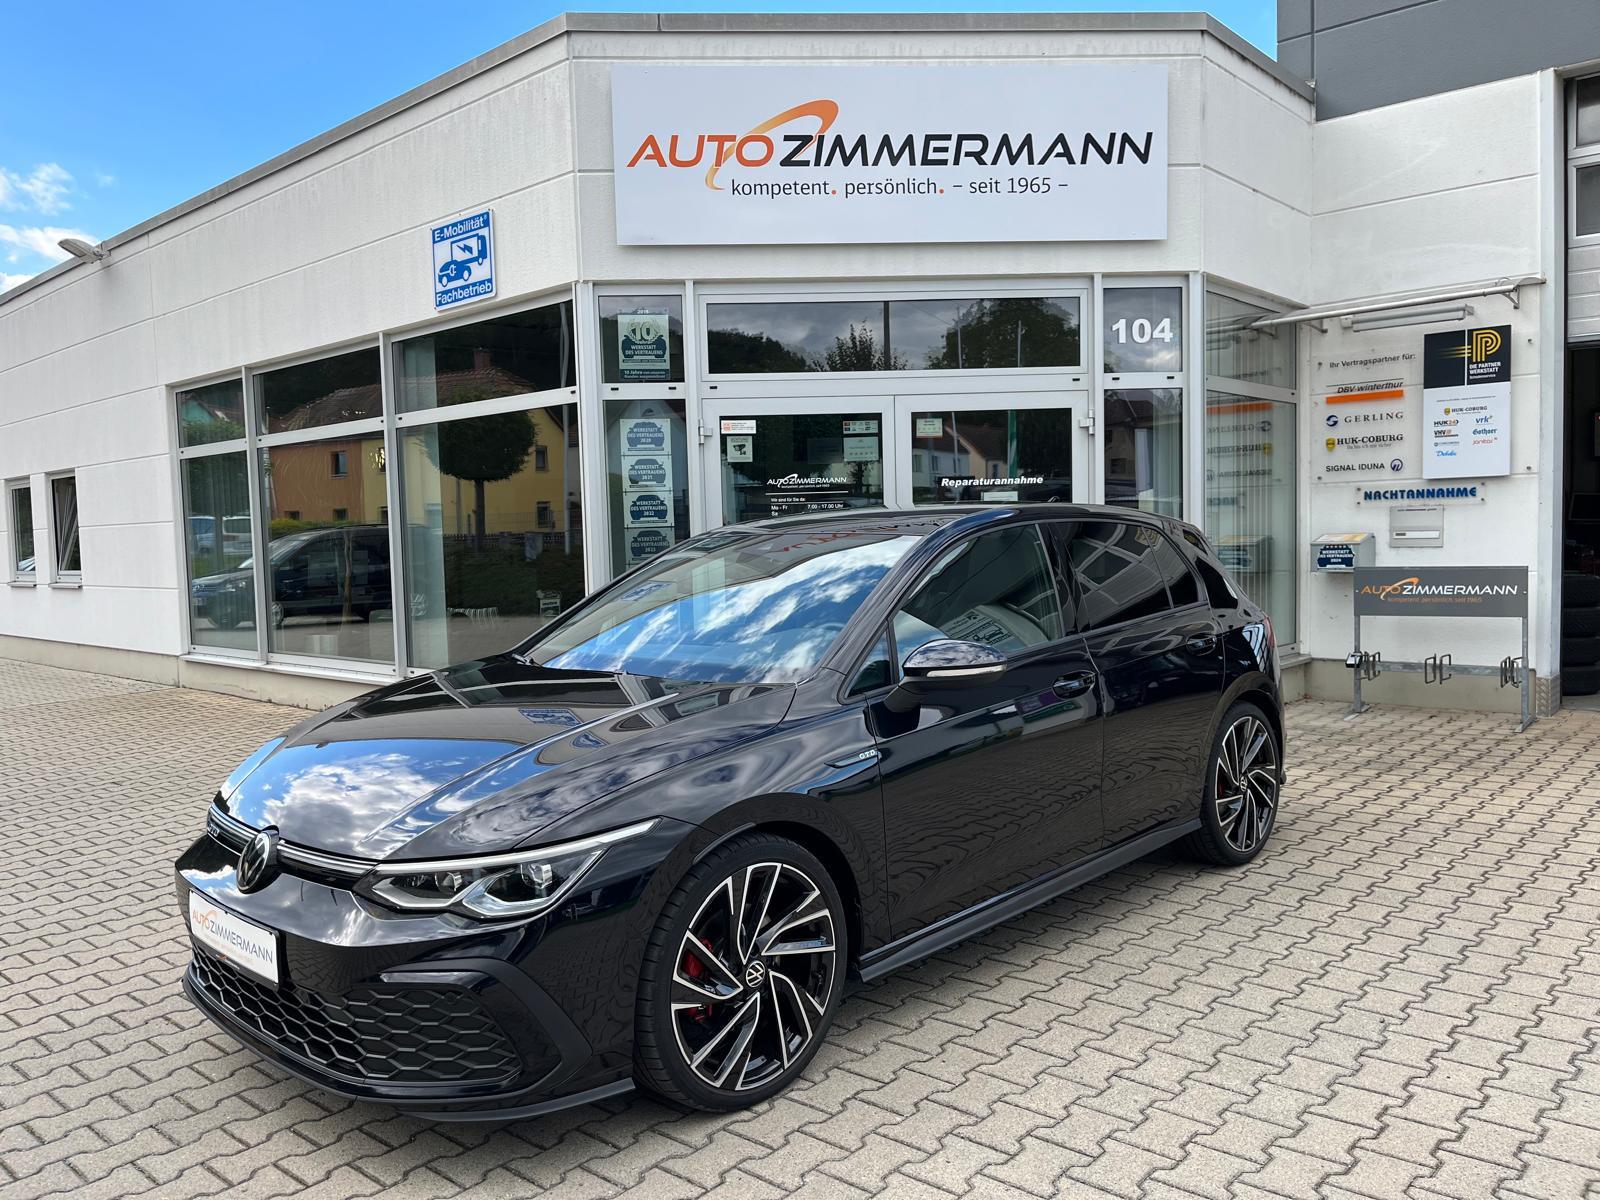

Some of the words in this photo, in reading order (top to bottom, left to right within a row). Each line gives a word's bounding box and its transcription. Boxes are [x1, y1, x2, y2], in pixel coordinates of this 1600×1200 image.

[731, 179, 838, 199] kompetent.
[845, 178, 945, 199] persönlich.
[969, 178, 1001, 194] seit
[1007, 177, 1051, 194] 1965
[436, 280, 492, 305] Fachbetrieb
[630, 320, 659, 341] 10
[1112, 318, 1173, 344] 104
[1341, 356, 1400, 367] Vertragspartner
[1478, 361, 1501, 369] PARTNER
[1344, 411, 1404, 423] GERLING
[1337, 434, 1404, 446] HUK-COBURG
[1326, 464, 1356, 472] SIGNAL
[1358, 463, 1385, 471] IDUNA
[941, 476, 1044, 488] Reparaturannahme
[1364, 486, 1477, 501] NACHTANNAHME
[859, 749, 876, 759] GTD
